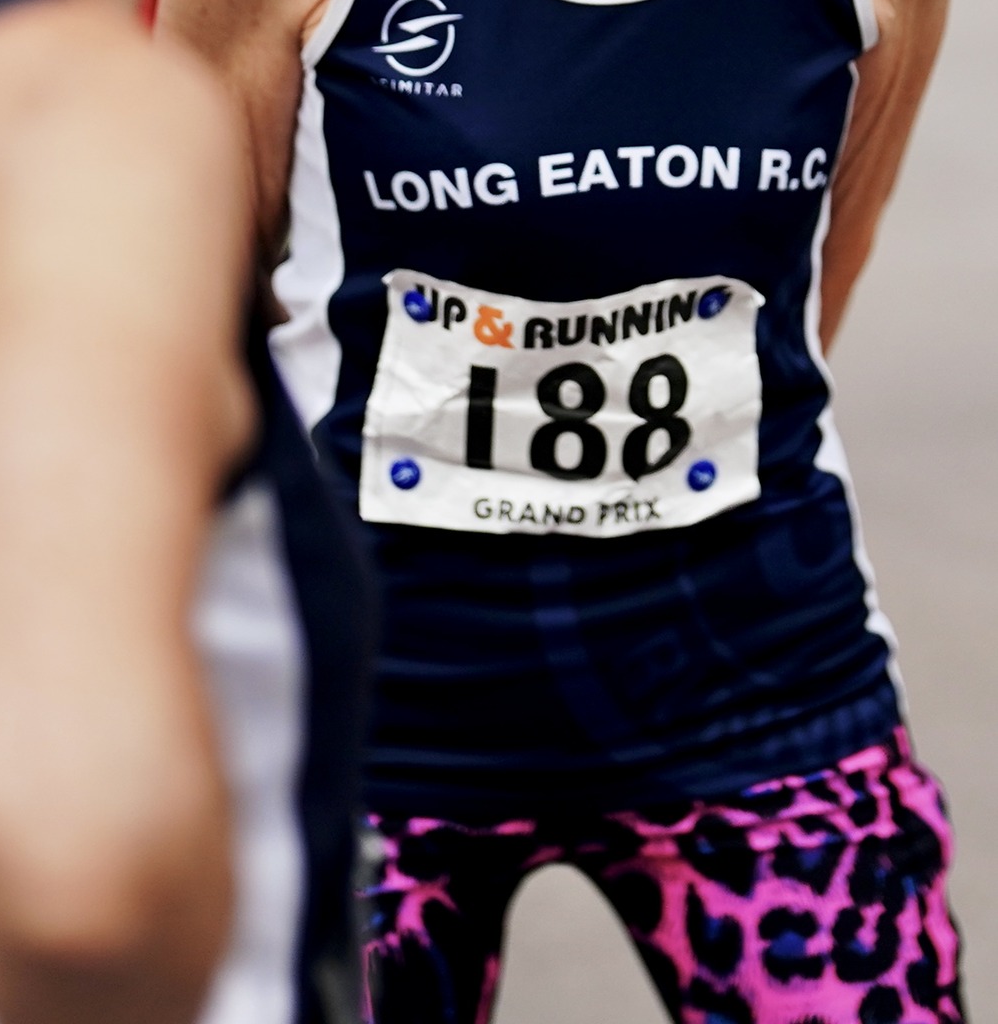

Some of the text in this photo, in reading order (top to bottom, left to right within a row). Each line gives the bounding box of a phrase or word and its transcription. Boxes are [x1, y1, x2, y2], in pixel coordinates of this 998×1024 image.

[371, 77, 463, 97] CIMITAR
[363, 163, 520, 212] LONG
[538, 144, 741, 197] EATON
[473, 304, 515, 349] &
[524, 284, 734, 349] RUNNIN
[464, 353, 692, 482] 188
[473, 495, 662, 526] GRAND PRIX
